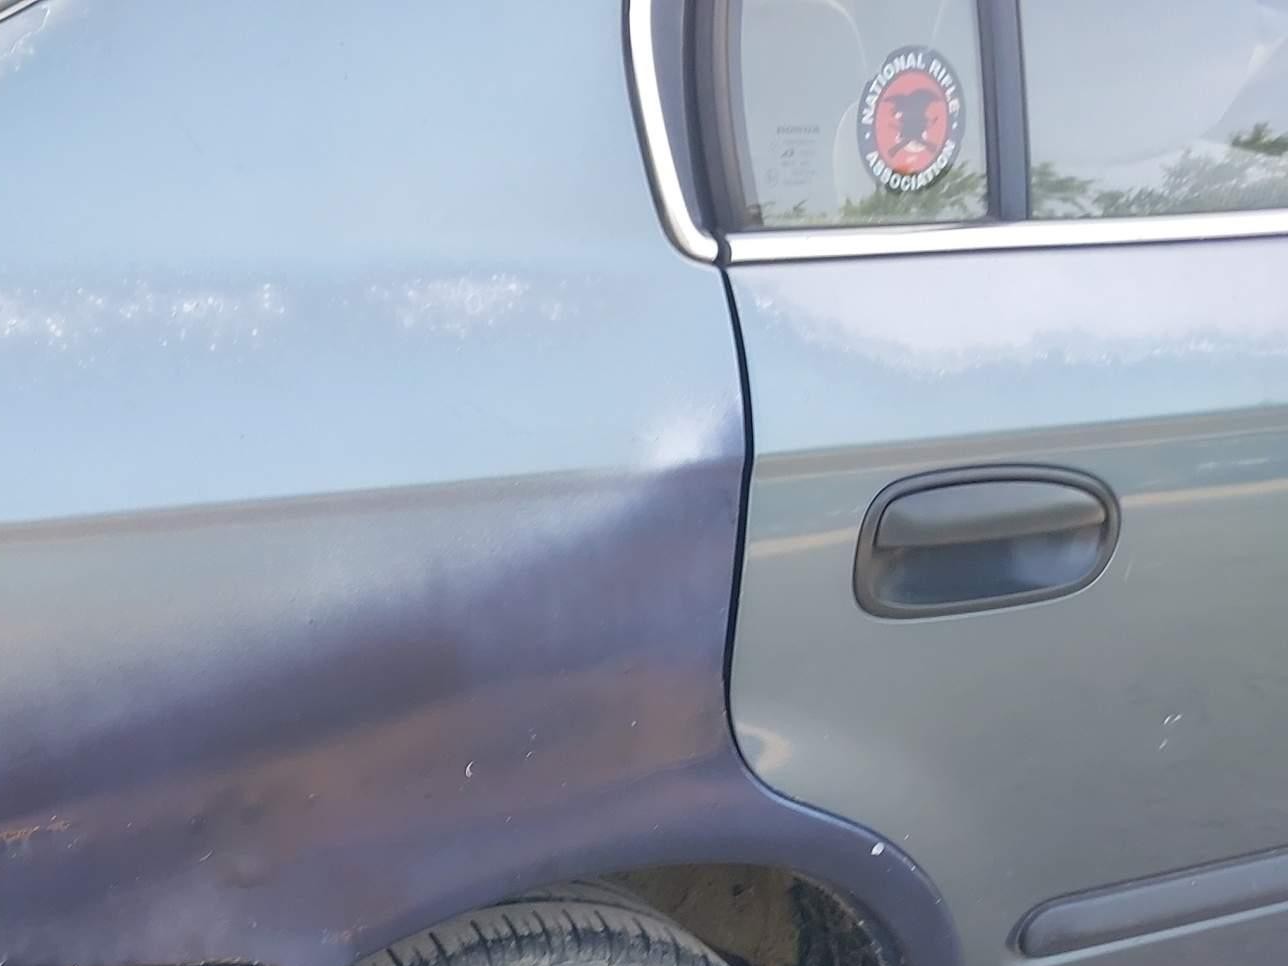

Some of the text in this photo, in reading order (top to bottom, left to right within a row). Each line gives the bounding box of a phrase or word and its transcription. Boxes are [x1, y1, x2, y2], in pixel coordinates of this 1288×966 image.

[861, 52, 961, 125] NATIONAL RIFLE
[865, 138, 956, 192] ASSOCIATION
